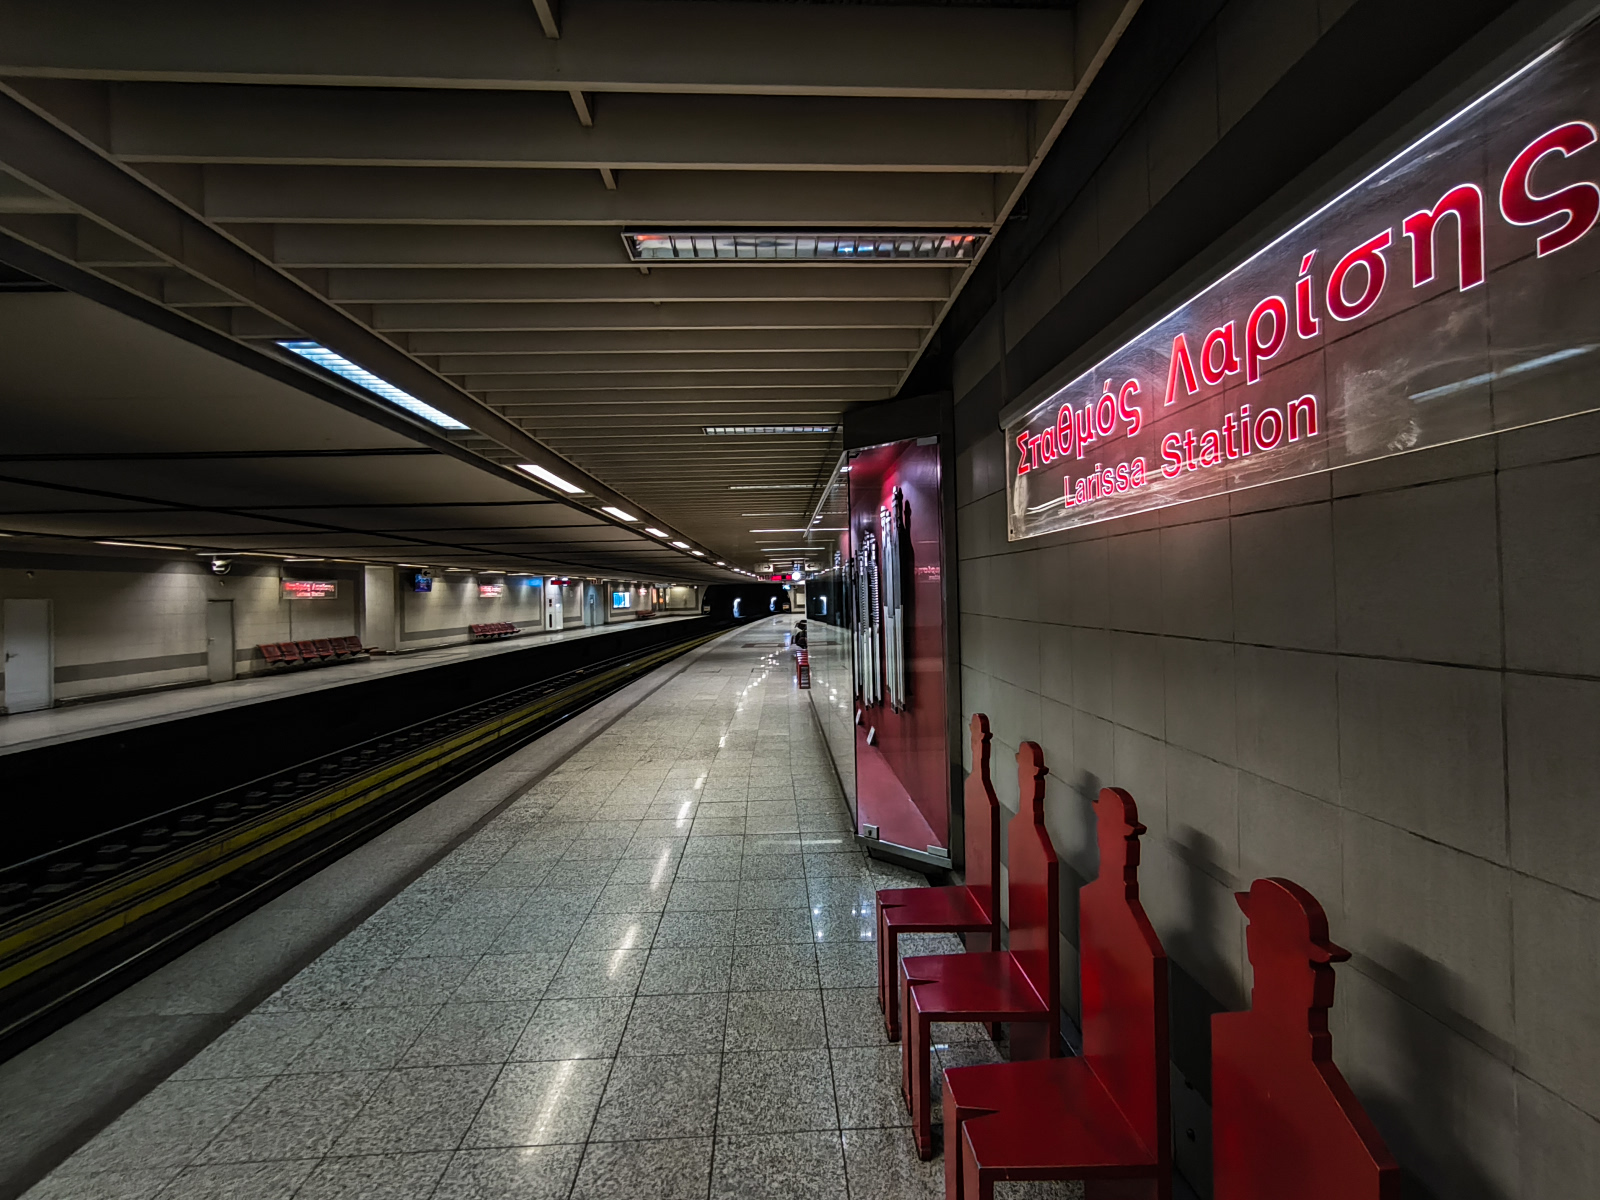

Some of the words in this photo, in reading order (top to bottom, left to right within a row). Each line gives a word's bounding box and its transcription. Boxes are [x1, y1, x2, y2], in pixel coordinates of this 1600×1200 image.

[1016, 378, 1142, 475] Σταθμός
[1164, 121, 1600, 407] Λαρίσης
[1063, 456, 1147, 508] Larissa
[1160, 394, 1319, 479] Station
